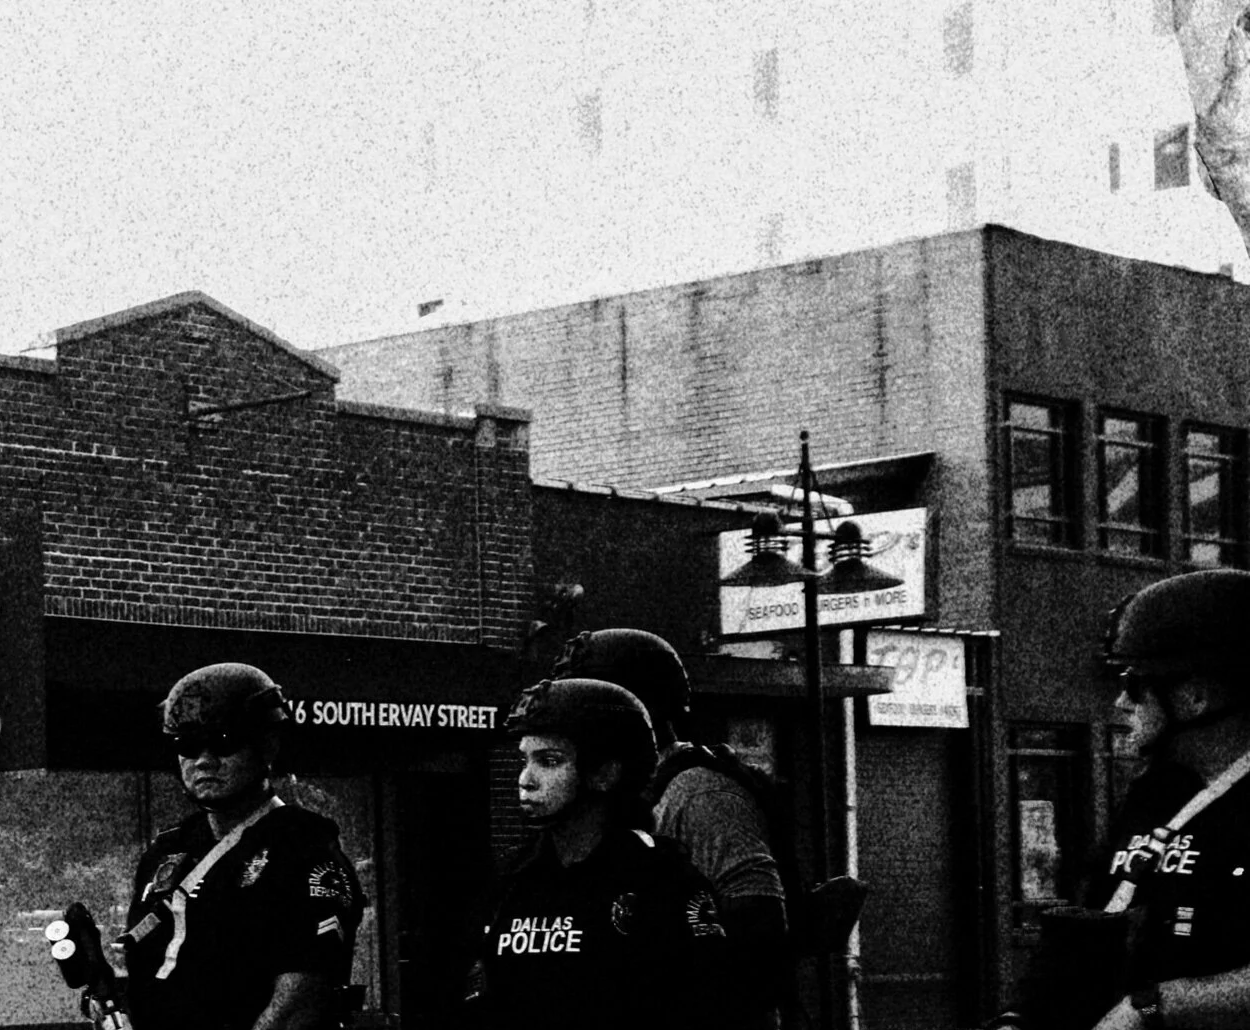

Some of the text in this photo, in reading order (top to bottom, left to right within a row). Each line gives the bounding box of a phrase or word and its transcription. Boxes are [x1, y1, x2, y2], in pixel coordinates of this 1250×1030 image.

[748, 602, 799, 621] SEAFOOD
[875, 590, 907, 606] MORE
[313, 701, 375, 725] SOUTH
[378, 703, 435, 727] ERVAY
[438, 705, 498, 729] STREET
[510, 916, 574, 933] DALLAS
[497, 930, 583, 956] POLICE
